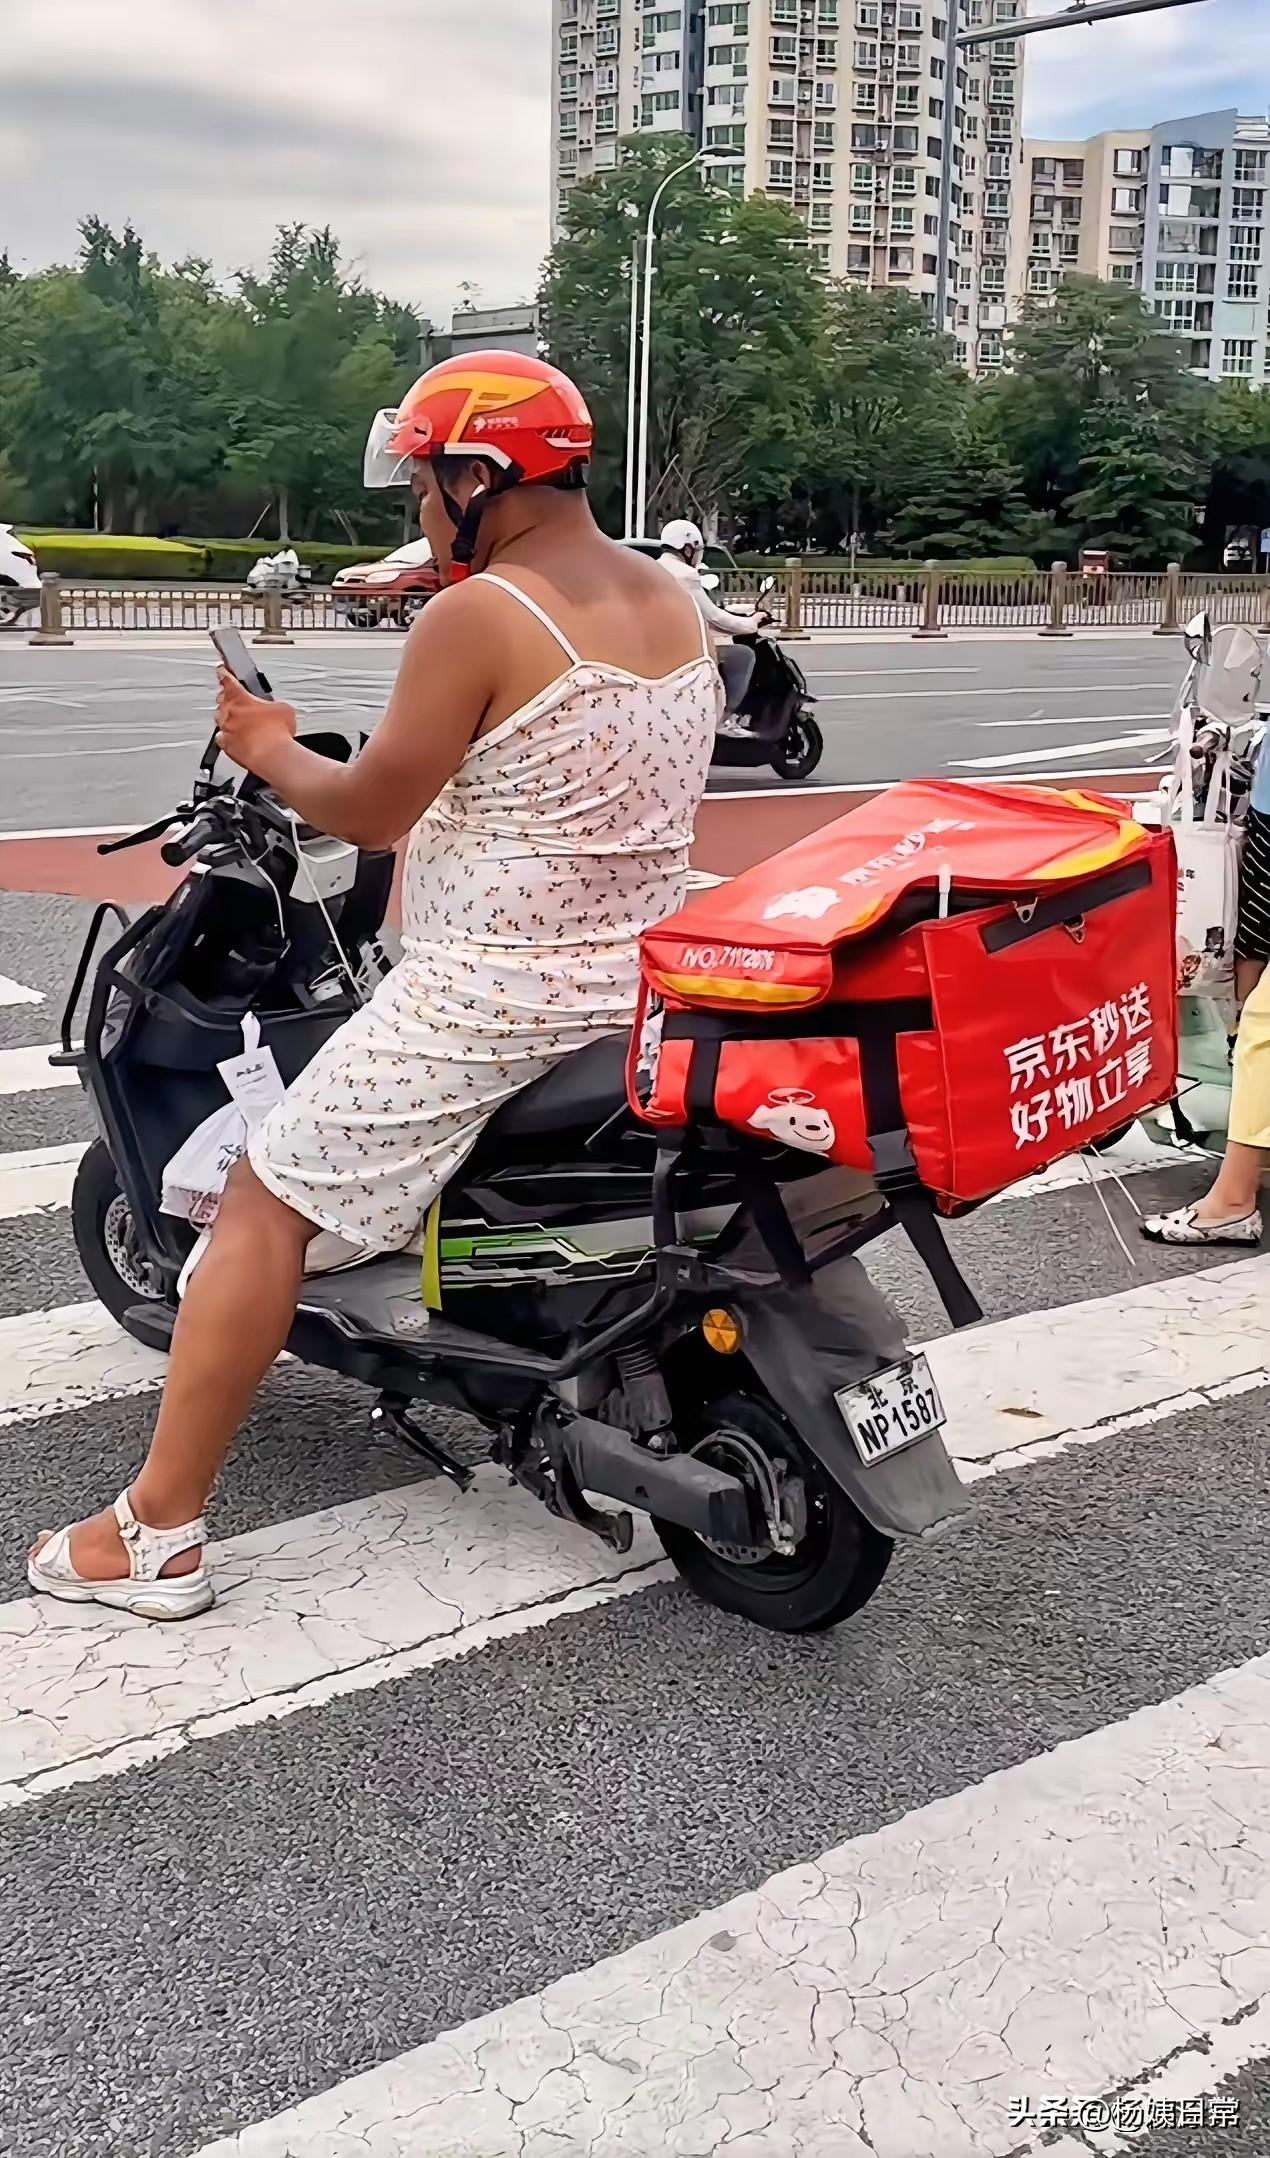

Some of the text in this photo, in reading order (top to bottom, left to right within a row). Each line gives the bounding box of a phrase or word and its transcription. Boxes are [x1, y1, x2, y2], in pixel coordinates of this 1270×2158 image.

[1003, 981, 1153, 1094] 京东秒送
[1009, 1036, 1153, 1150] 好物立享
[857, 1387, 938, 1454] NP1587
